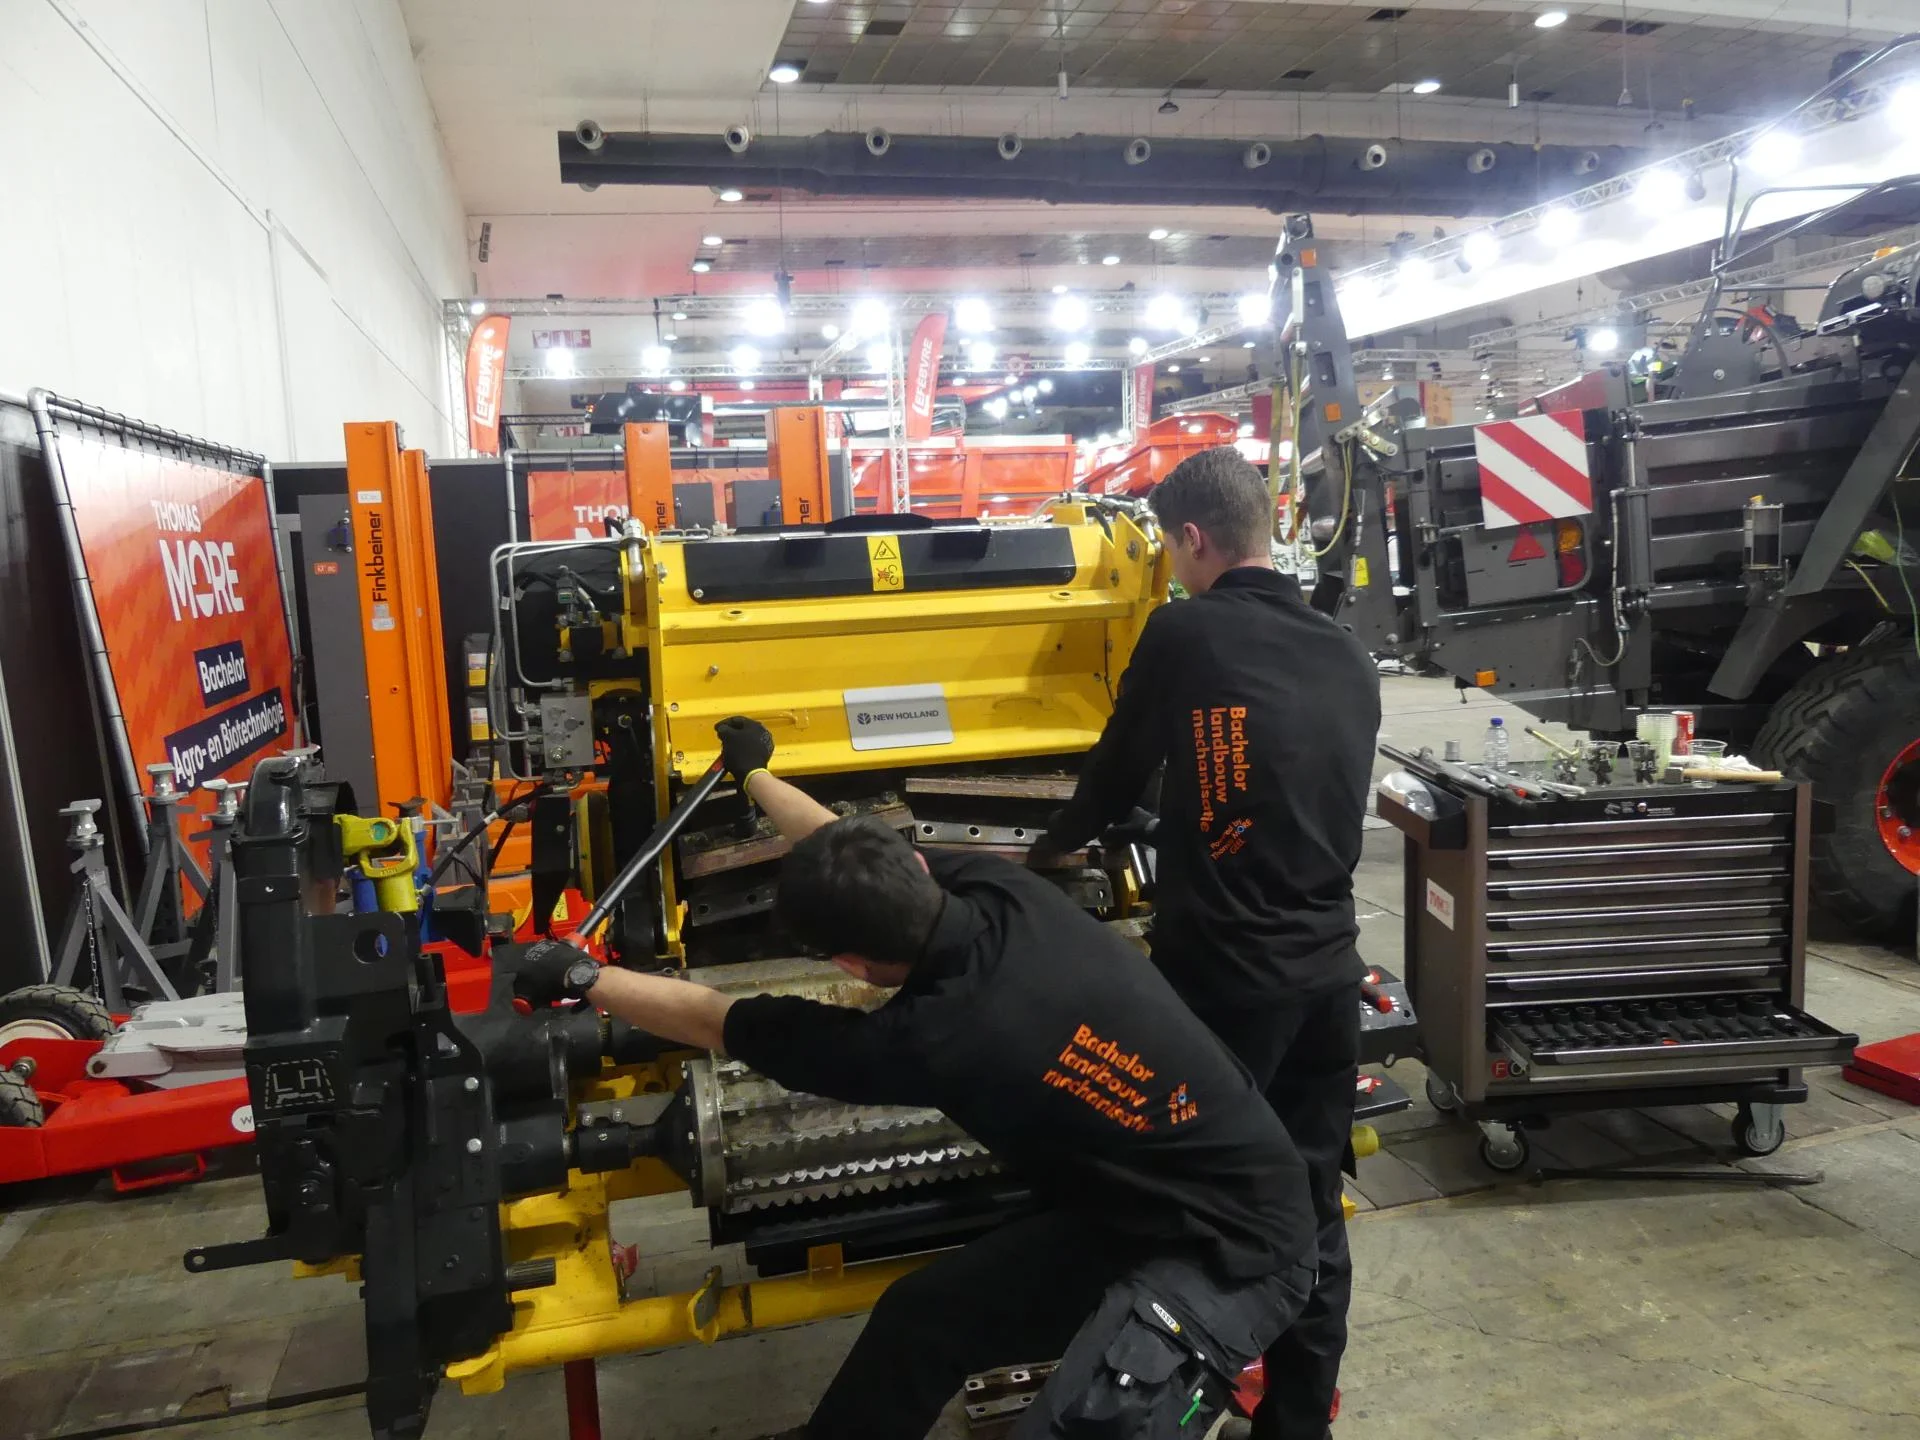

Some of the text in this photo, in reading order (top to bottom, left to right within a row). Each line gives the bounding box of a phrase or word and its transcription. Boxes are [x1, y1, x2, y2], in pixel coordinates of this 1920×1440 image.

[912, 337, 933, 417] LEFEBVRE
[151, 500, 201, 532] THOMAS
[365, 510, 387, 603] Finkbeiner
[159, 539, 245, 622] MORE
[199, 651, 246, 694] Bachelor
[172, 696, 285, 788] Agro- en Biotechnologie
[873, 710, 939, 722] NEW HOLLAND
[1210, 707, 1230, 804] landbouw
[1229, 706, 1251, 792] Bachelor
[1192, 707, 1215, 832] mechanisatie
[1058, 1043, 1148, 1108] landbouw
[1073, 1023, 1155, 1082] Bachelor
